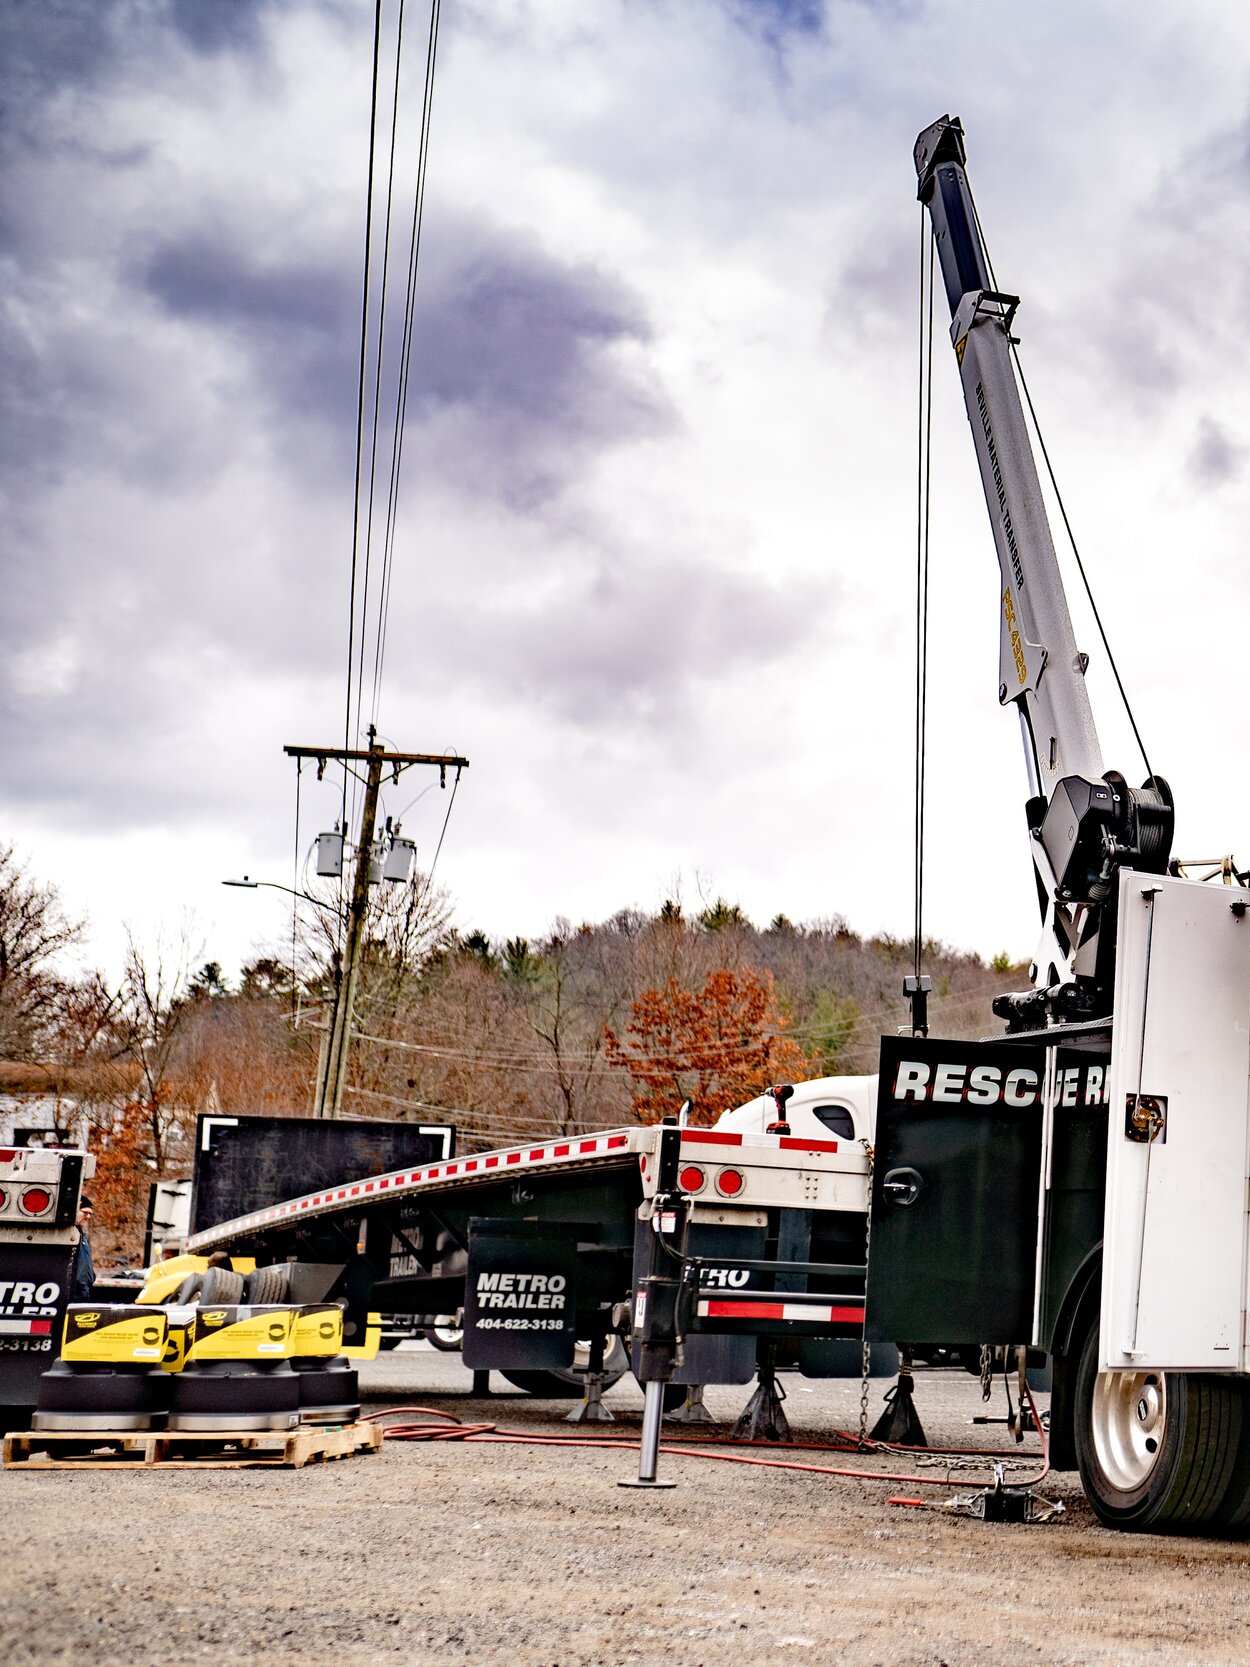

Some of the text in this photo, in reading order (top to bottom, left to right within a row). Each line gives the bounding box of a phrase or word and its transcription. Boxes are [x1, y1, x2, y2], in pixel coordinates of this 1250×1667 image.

[988, 437, 1006, 512] MATERIAL
[1003, 508, 1024, 590] TRANSFER
[1003, 587, 1027, 684] PSC 4329
[894, 1061, 1080, 1108] RESCUE
[476, 1273, 566, 1293] METRO
[477, 1292, 566, 1309] TRAILER
[475, 1318, 564, 1330] 404-622-3138
